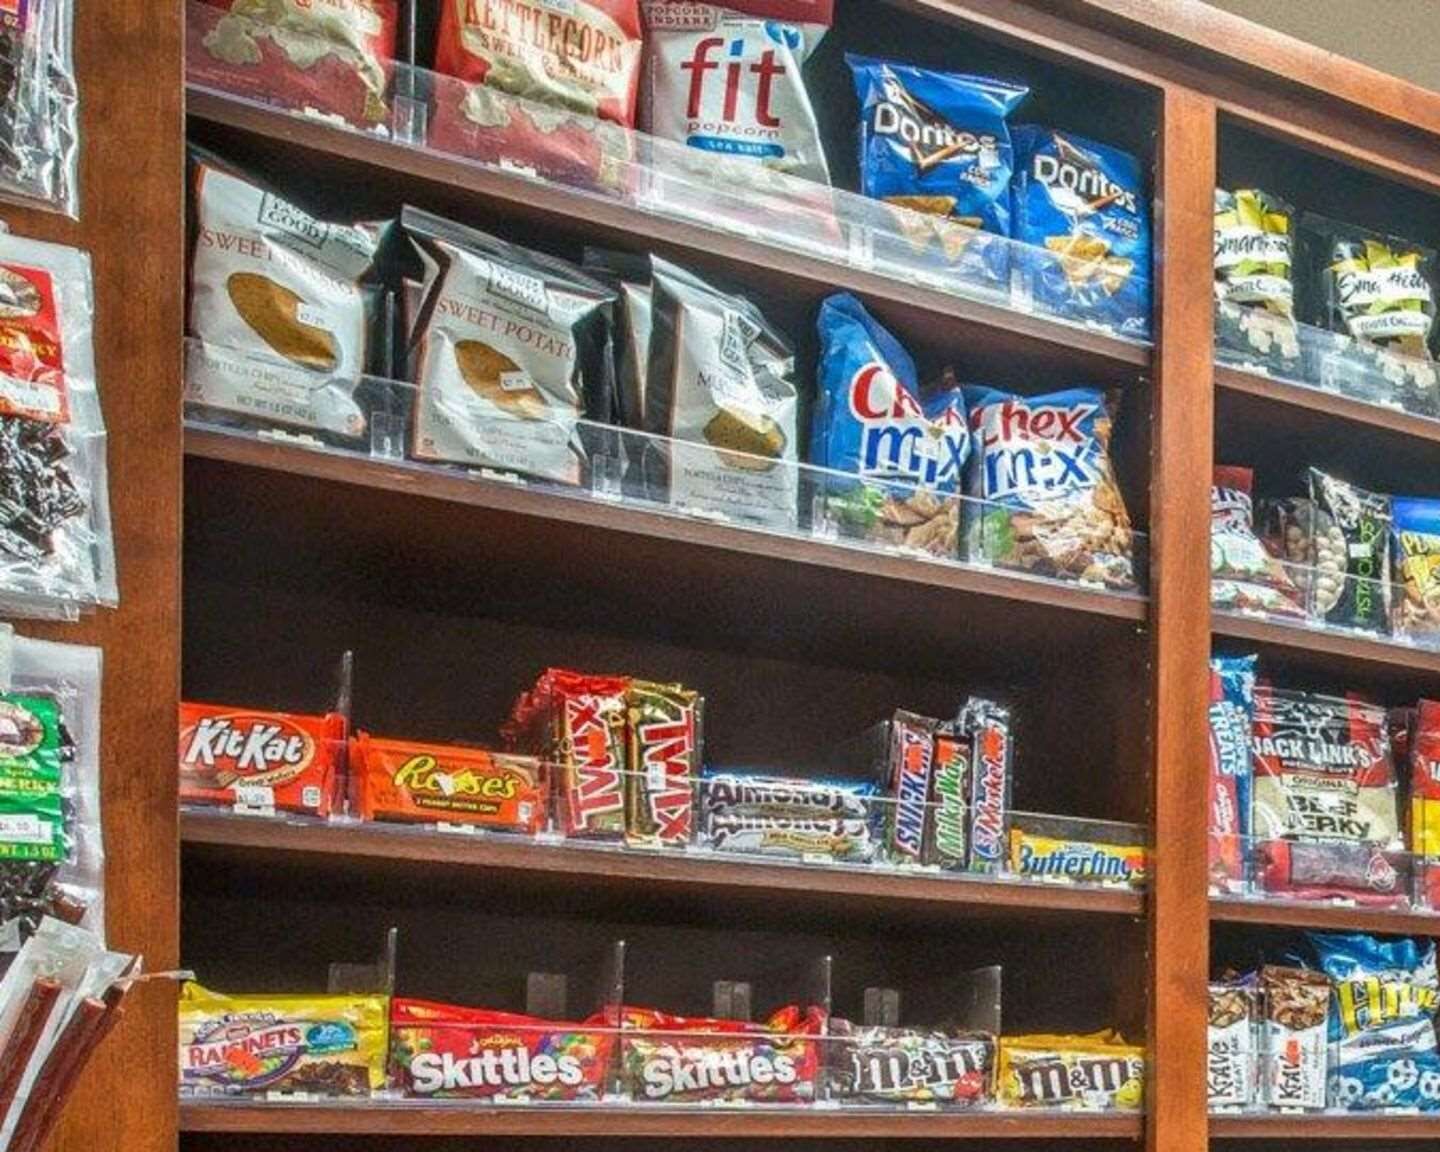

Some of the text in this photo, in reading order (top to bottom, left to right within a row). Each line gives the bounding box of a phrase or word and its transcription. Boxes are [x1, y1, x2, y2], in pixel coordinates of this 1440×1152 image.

[648, 15, 712, 27] INDIANA
[681, 38, 786, 128] fit
[687, 119, 782, 139] popcorn
[873, 102, 997, 154] Doritos
[1033, 154, 1137, 214] Doritos
[201, 230, 272, 261] SWEET
[268, 211, 320, 239] GOOD
[438, 299, 497, 332] SWEET
[972, 401, 1098, 447] Chex
[566, 696, 624, 831] TWIX
[641, 705, 695, 843] TWIX
[1252, 736, 1306, 762] JACK
[1306, 741, 1372, 769] LINK'S
[393, 755, 520, 801] Rese's
[895, 730, 933, 856] SNICKS
[1281, 814, 1371, 838] JERKY
[1286, 794, 1358, 817] BEEF
[1021, 844, 1150, 883] Butterfing
[411, 1047, 585, 1095] Skittles
[643, 1046, 799, 1099] Skittles
